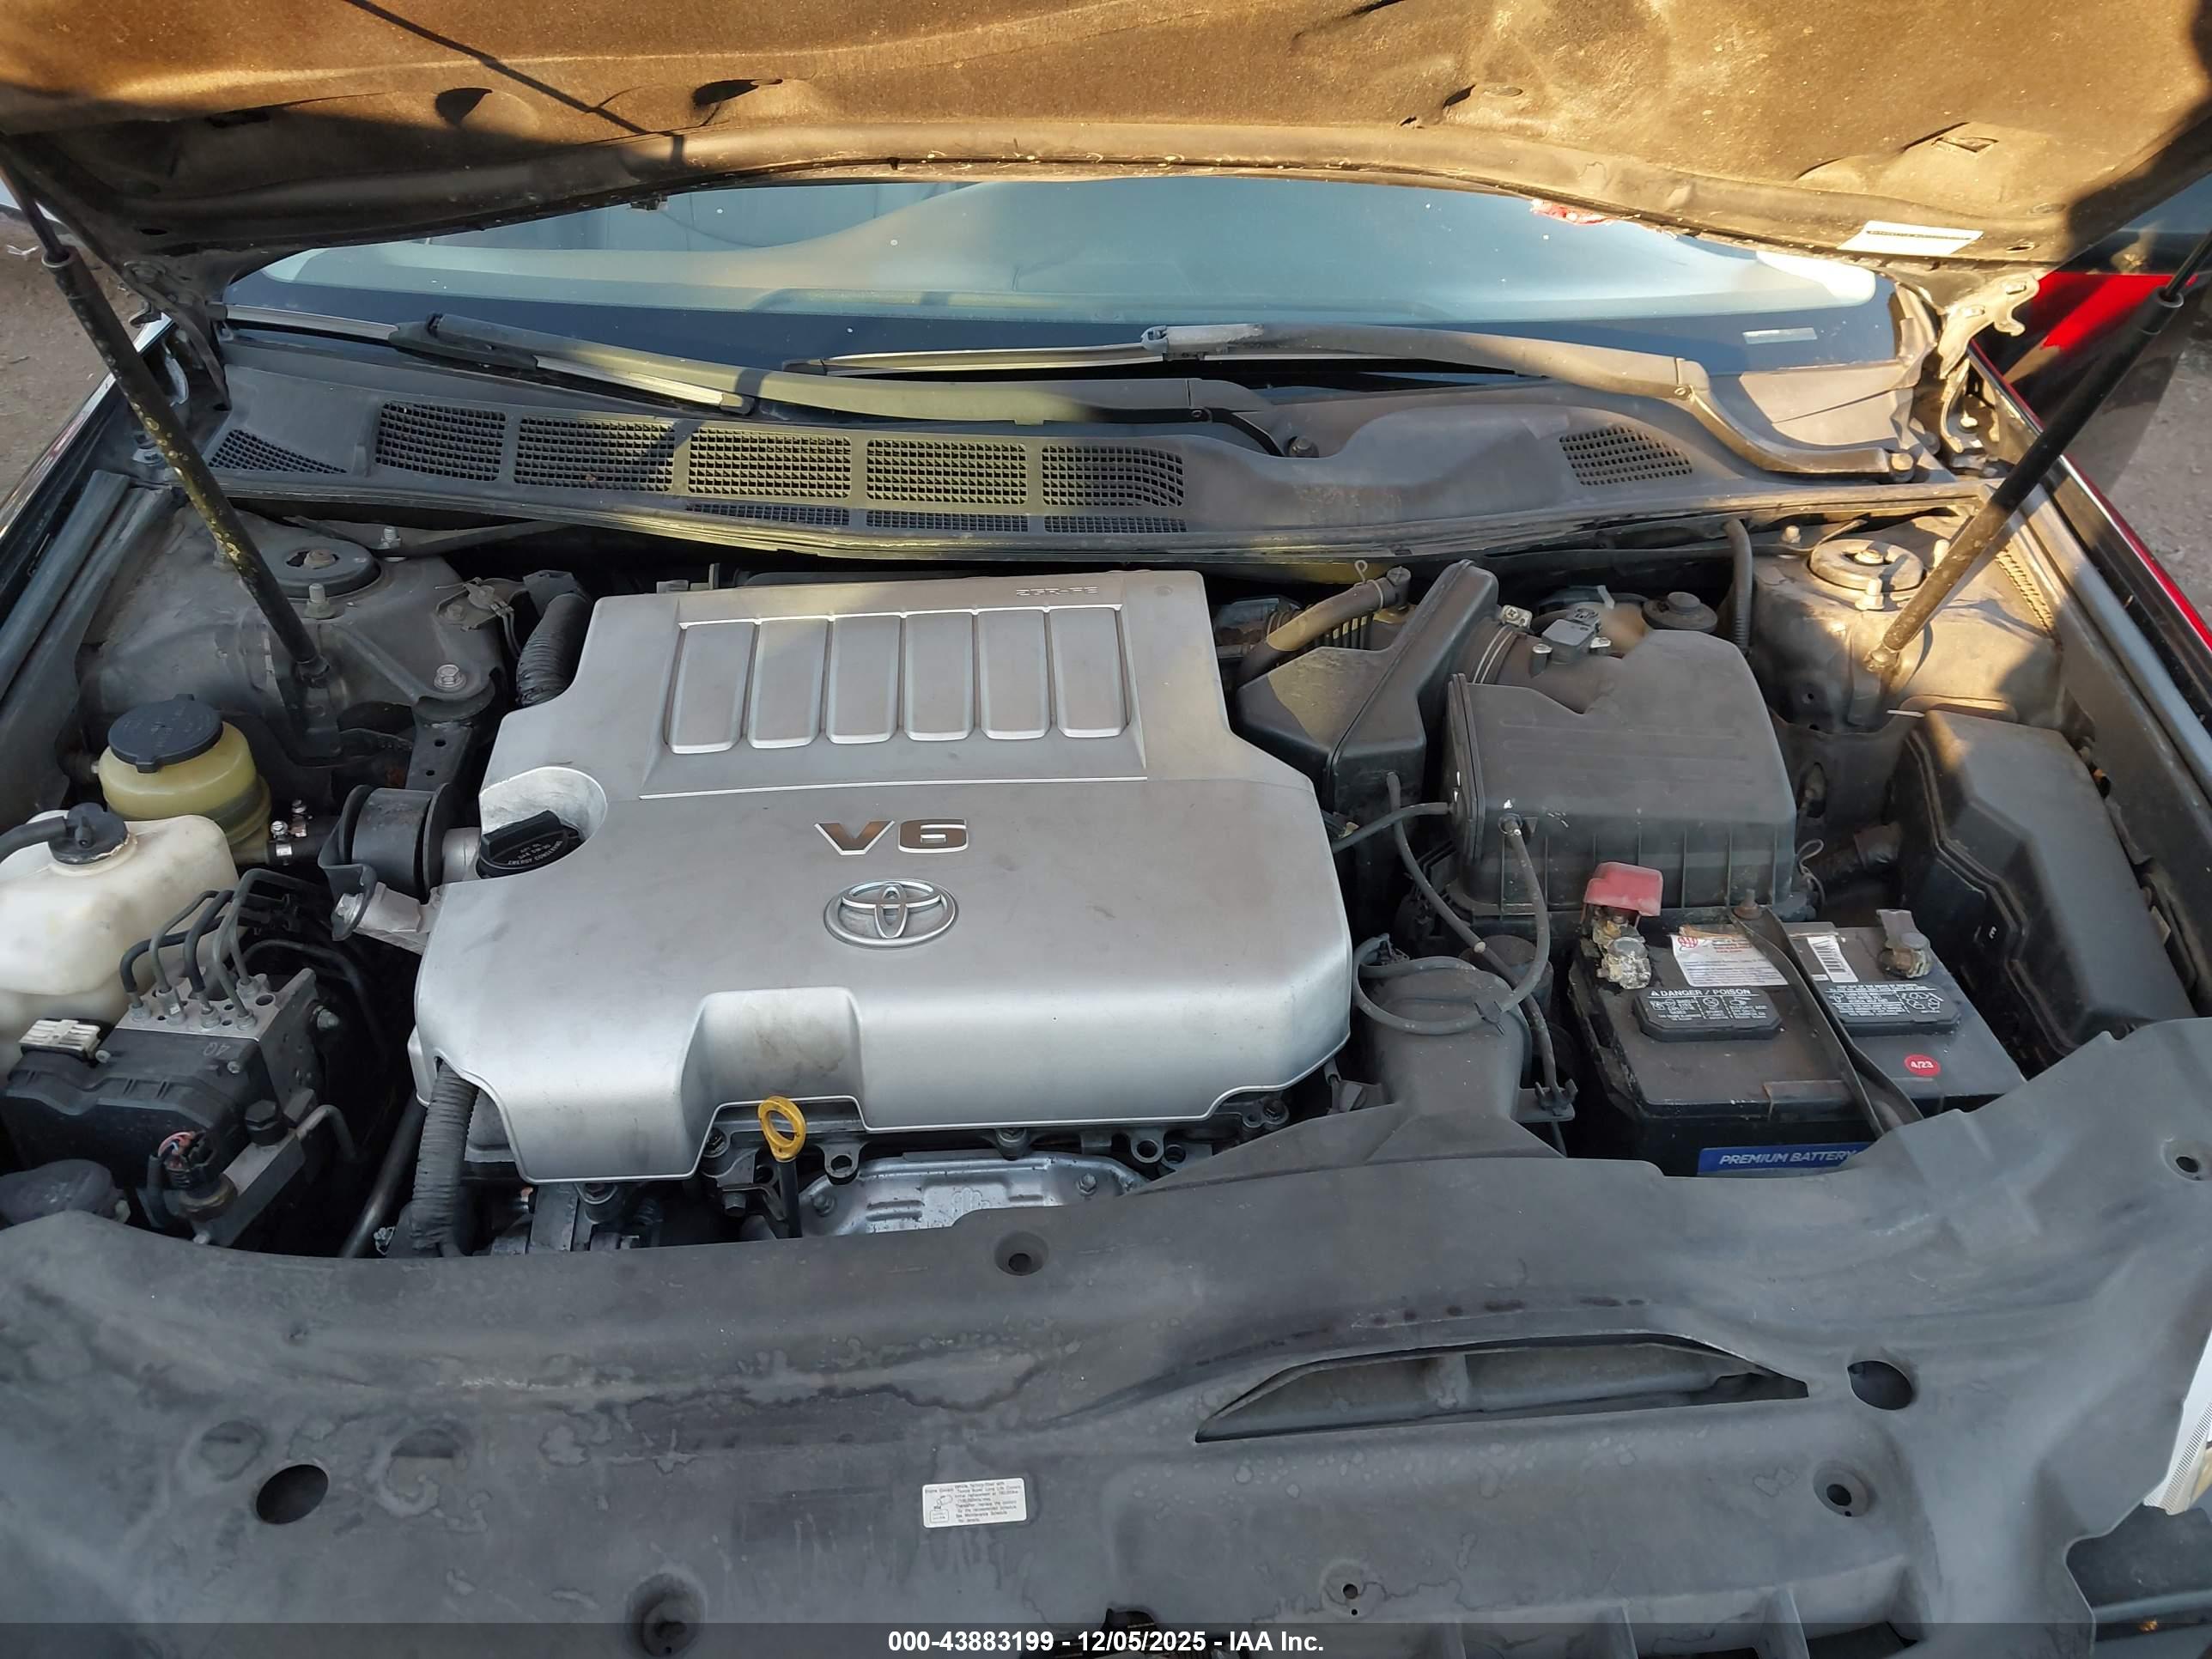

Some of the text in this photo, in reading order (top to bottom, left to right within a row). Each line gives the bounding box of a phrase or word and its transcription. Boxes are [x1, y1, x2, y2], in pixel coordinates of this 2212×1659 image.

[813, 817, 969, 856] V6
[1660, 988, 1703, 997] DANGER
[1911, 1060, 1935, 1069] 4/23
[1719, 1153, 1789, 1165] PREMIUM
